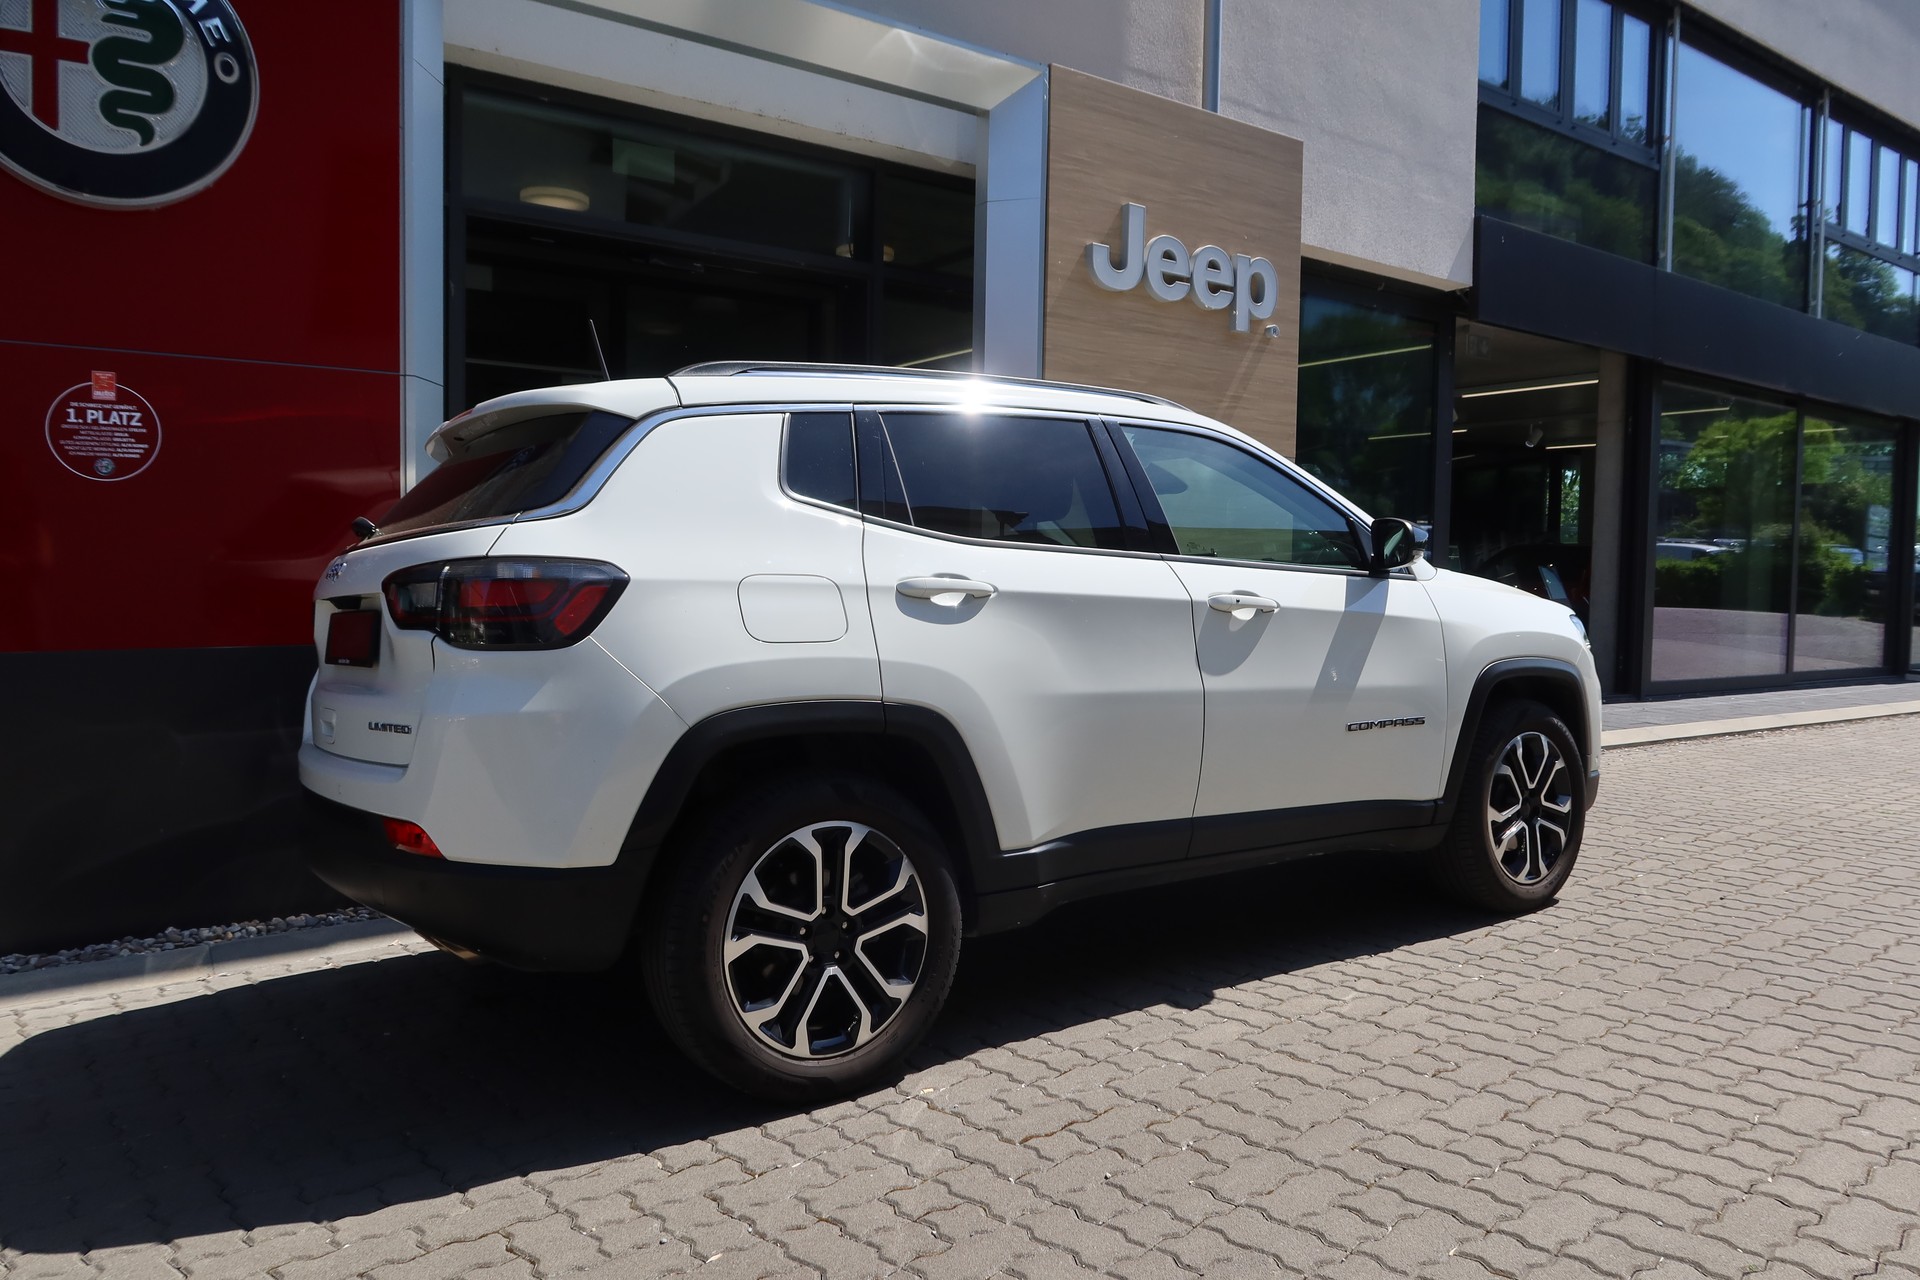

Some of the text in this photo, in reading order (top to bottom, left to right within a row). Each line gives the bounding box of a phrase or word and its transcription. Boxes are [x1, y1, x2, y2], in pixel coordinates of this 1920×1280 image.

[1085, 202, 1279, 332] Jeep
[66, 408, 142, 426] 1. PLATZ
[368, 721, 412, 735] LIMITED
[1346, 716, 1426, 732] COMPASS
